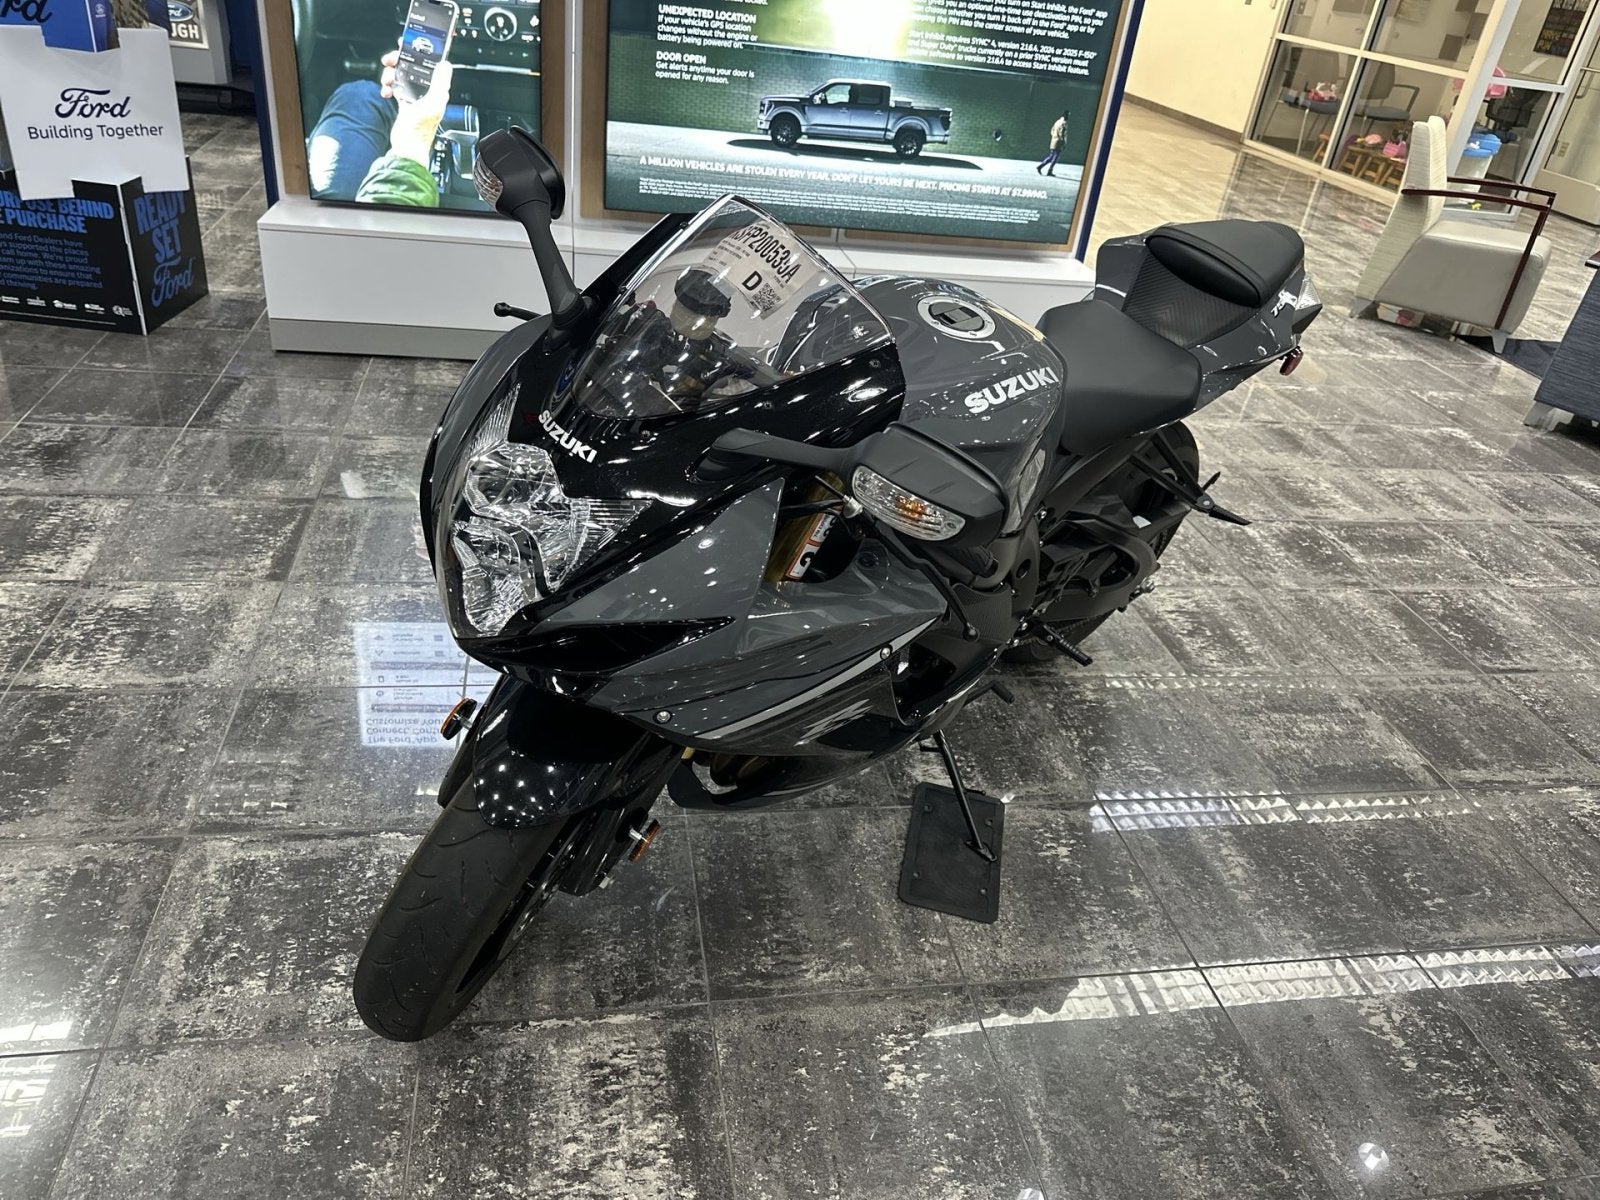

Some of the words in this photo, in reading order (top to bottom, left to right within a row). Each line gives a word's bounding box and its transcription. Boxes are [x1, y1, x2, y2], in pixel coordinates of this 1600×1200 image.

[658, 4, 714, 19] UNEXPECTED
[715, 10, 757, 24] LOCATION
[925, 5, 947, 15] choose
[948, 8, 974, 19] whether
[974, 12, 986, 20] you
[986, 13, 1001, 21] turn
[1007, 15, 1021, 24] back
[1038, 20, 1050, 28] the
[1066, 24, 1079, 32] app
[1087, 26, 1096, 35] by
[967, 3, 993, 12] optional
[1021, 9, 1033, 17] use
[1033, 10, 1070, 22] deactivation
[1092, 18, 1104, 26] you
[1031, 1, 1046, 10] Start
[1067, 5, 1079, 14] the
[1095, 10, 1108, 19] app
[657, 24, 686, 34] changes
[687, 27, 713, 37] without
[714, 30, 726, 38] the
[726, 33, 750, 41] engine
[664, 16, 680, 24] your
[710, 20, 724, 29] GPS
[725, 21, 752, 32] location
[960, 18, 973, 27] into
[973, 20, 984, 28] the
[1004, 24, 1025, 33] screen
[1033, 28, 1047, 36] your
[657, 32, 681, 44] battery
[682, 35, 702, 46] being
[703, 38, 732, 48] powered
[945, 34, 970, 44] requires
[997, 41, 1020, 50] version
[656, 51, 682, 62] DOOR
[683, 53, 706, 65] OPEN
[964, 54, 986, 63] version
[1032, 61, 1048, 70] Start
[1047, 63, 1067, 73] Inhibit
[977, 47, 1004, 57] currently
[1004, 50, 1014, 58] on
[1019, 51, 1034, 60] prior
[1051, 56, 1073, 65] version
[1073, 59, 1089, 67] must
[655, 71, 680, 79] opened
[681, 72, 691, 80] for
[692, 74, 705, 83] any
[705, 76, 729, 84] reason.
[656, 61, 668, 70] Get
[669, 62, 688, 72] alerts
[689, 64, 715, 75] anytime
[716, 68, 732, 76] your
[732, 68, 748, 78] door
[55, 88, 131, 118] Ford
[27, 125, 94, 141] Building
[97, 123, 164, 140] Together
[640, 155, 647, 166] A
[647, 156, 684, 168] MILLION
[684, 158, 726, 172] VEHICLES
[726, 163, 744, 174] ARE
[744, 164, 778, 177] STOLEN
[778, 167, 806, 179] EVERY
[831, 172, 857, 184] DON'T
[873, 175, 903, 188] YOURS
[903, 178, 914, 189] BE
[938, 181, 971, 193] PRICING
[971, 184, 1000, 196] STARTS
[1000, 187, 1012, 197] AT
[57, 198, 115, 220] BEHIND
[132, 190, 187, 235] READY
[5, 207, 87, 233] PURCHASE
[151, 219, 181, 263] SET
[151, 256, 196, 308] Ford
[741, 270, 763, 291] D
[965, 367, 1059, 414] SUZUKI
[538, 410, 598, 463] SUZUKI
